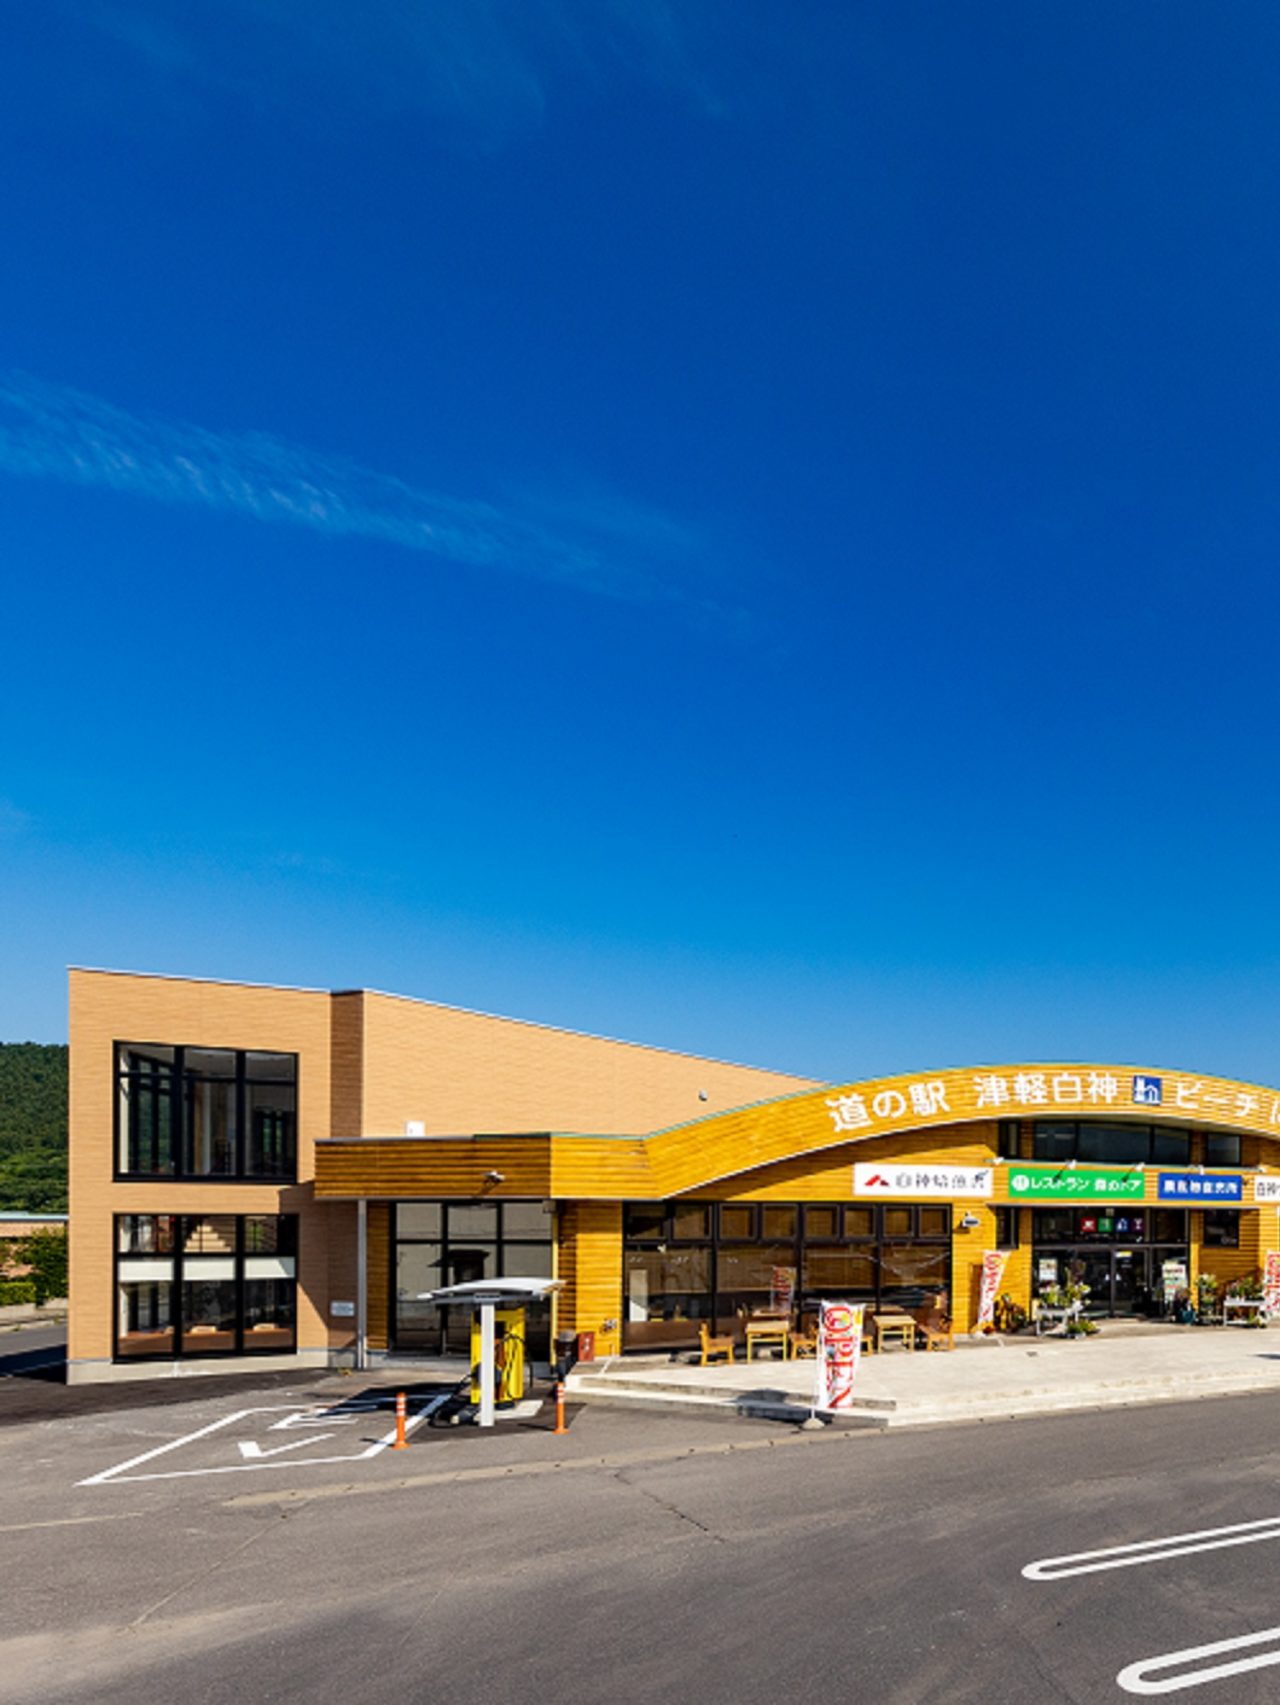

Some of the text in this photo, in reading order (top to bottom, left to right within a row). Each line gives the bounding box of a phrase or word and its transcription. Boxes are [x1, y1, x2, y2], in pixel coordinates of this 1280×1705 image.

[827, 1080, 950, 1132] 道の駅
[973, 1073, 1118, 1108] 津軽白神
[1030, 1177, 1089, 1191] レストラン
[824, 1306, 855, 1409] OPEN
